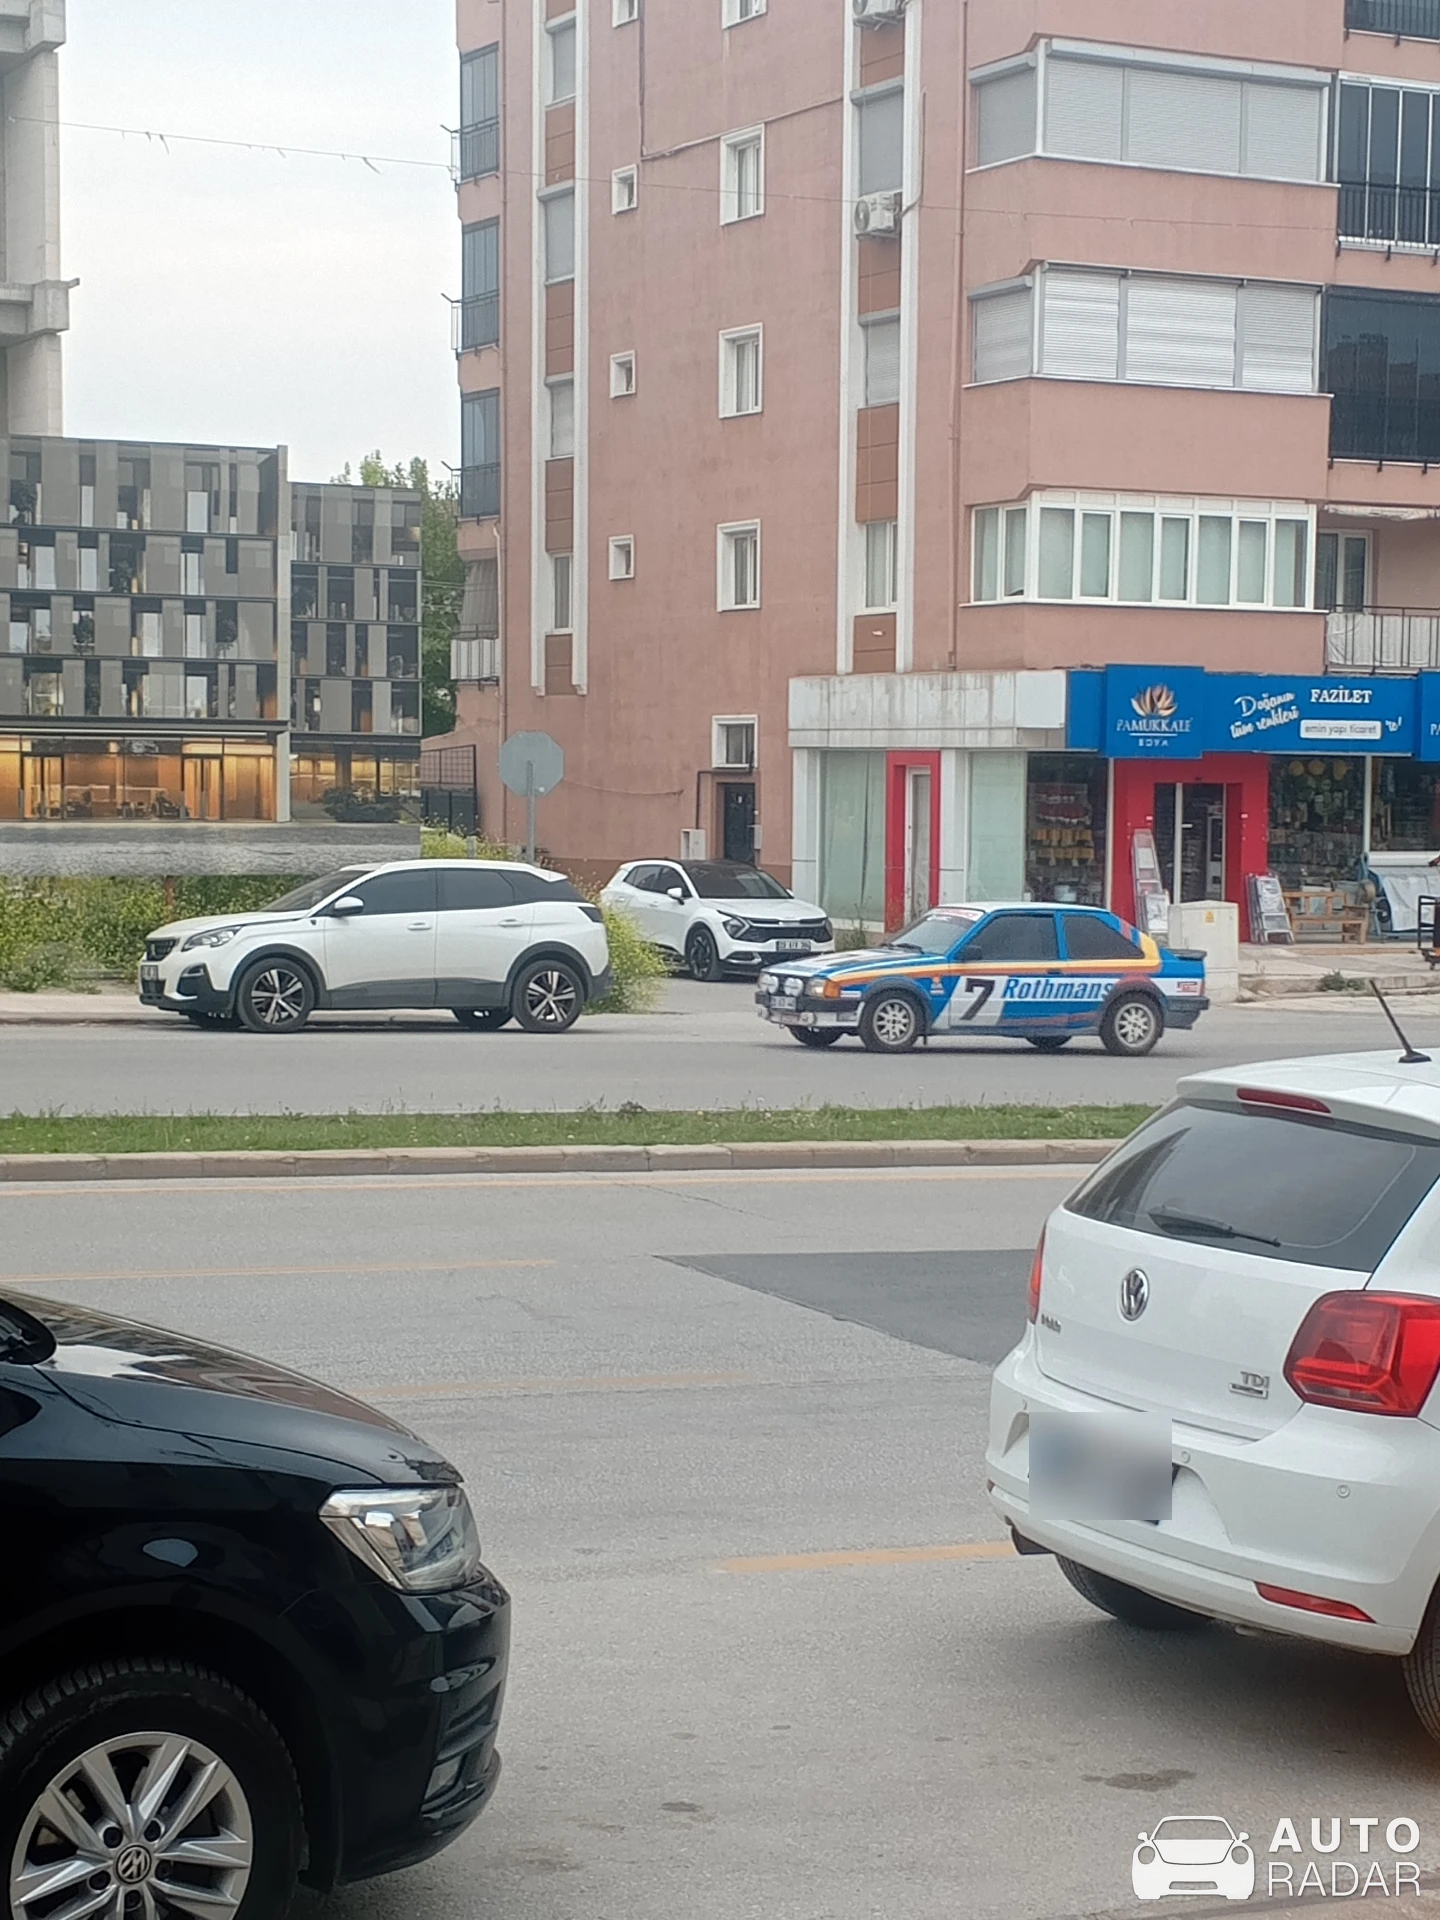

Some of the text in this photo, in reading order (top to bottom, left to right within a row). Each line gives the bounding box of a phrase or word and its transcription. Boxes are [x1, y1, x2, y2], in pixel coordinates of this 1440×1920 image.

[1310, 685, 1372, 703] FAZİLET
[1116, 718, 1191, 732] PAMUKKALE
[1001, 978, 1116, 1000] Rothmans
[960, 977, 996, 1021] 7
[1240, 1370, 1270, 1389] TDI
